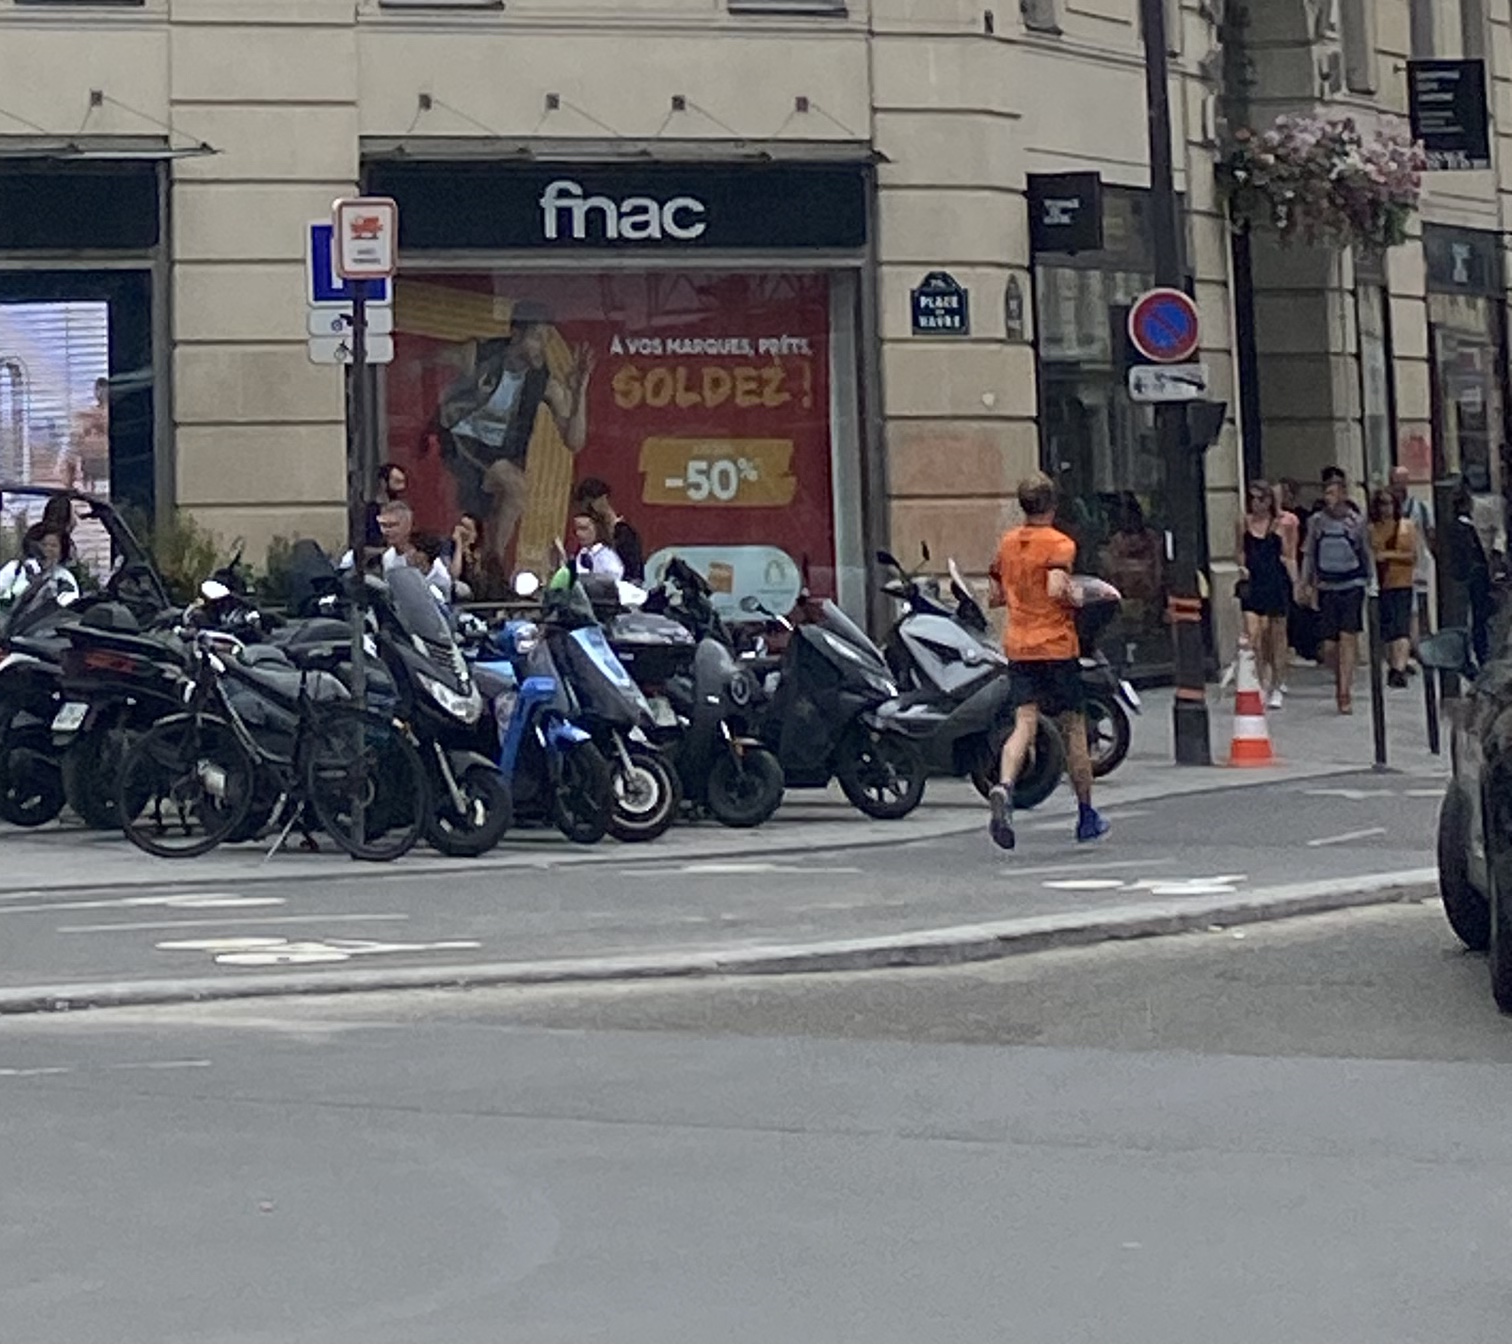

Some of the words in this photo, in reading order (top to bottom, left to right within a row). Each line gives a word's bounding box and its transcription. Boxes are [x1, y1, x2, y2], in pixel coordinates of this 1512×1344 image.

[540, 180, 708, 239] fnac
[626, 338, 663, 354] VOS
[666, 338, 754, 357] MARQUES,
[611, 364, 792, 410] SOLDEZ
[664, 457, 759, 501] -50%
